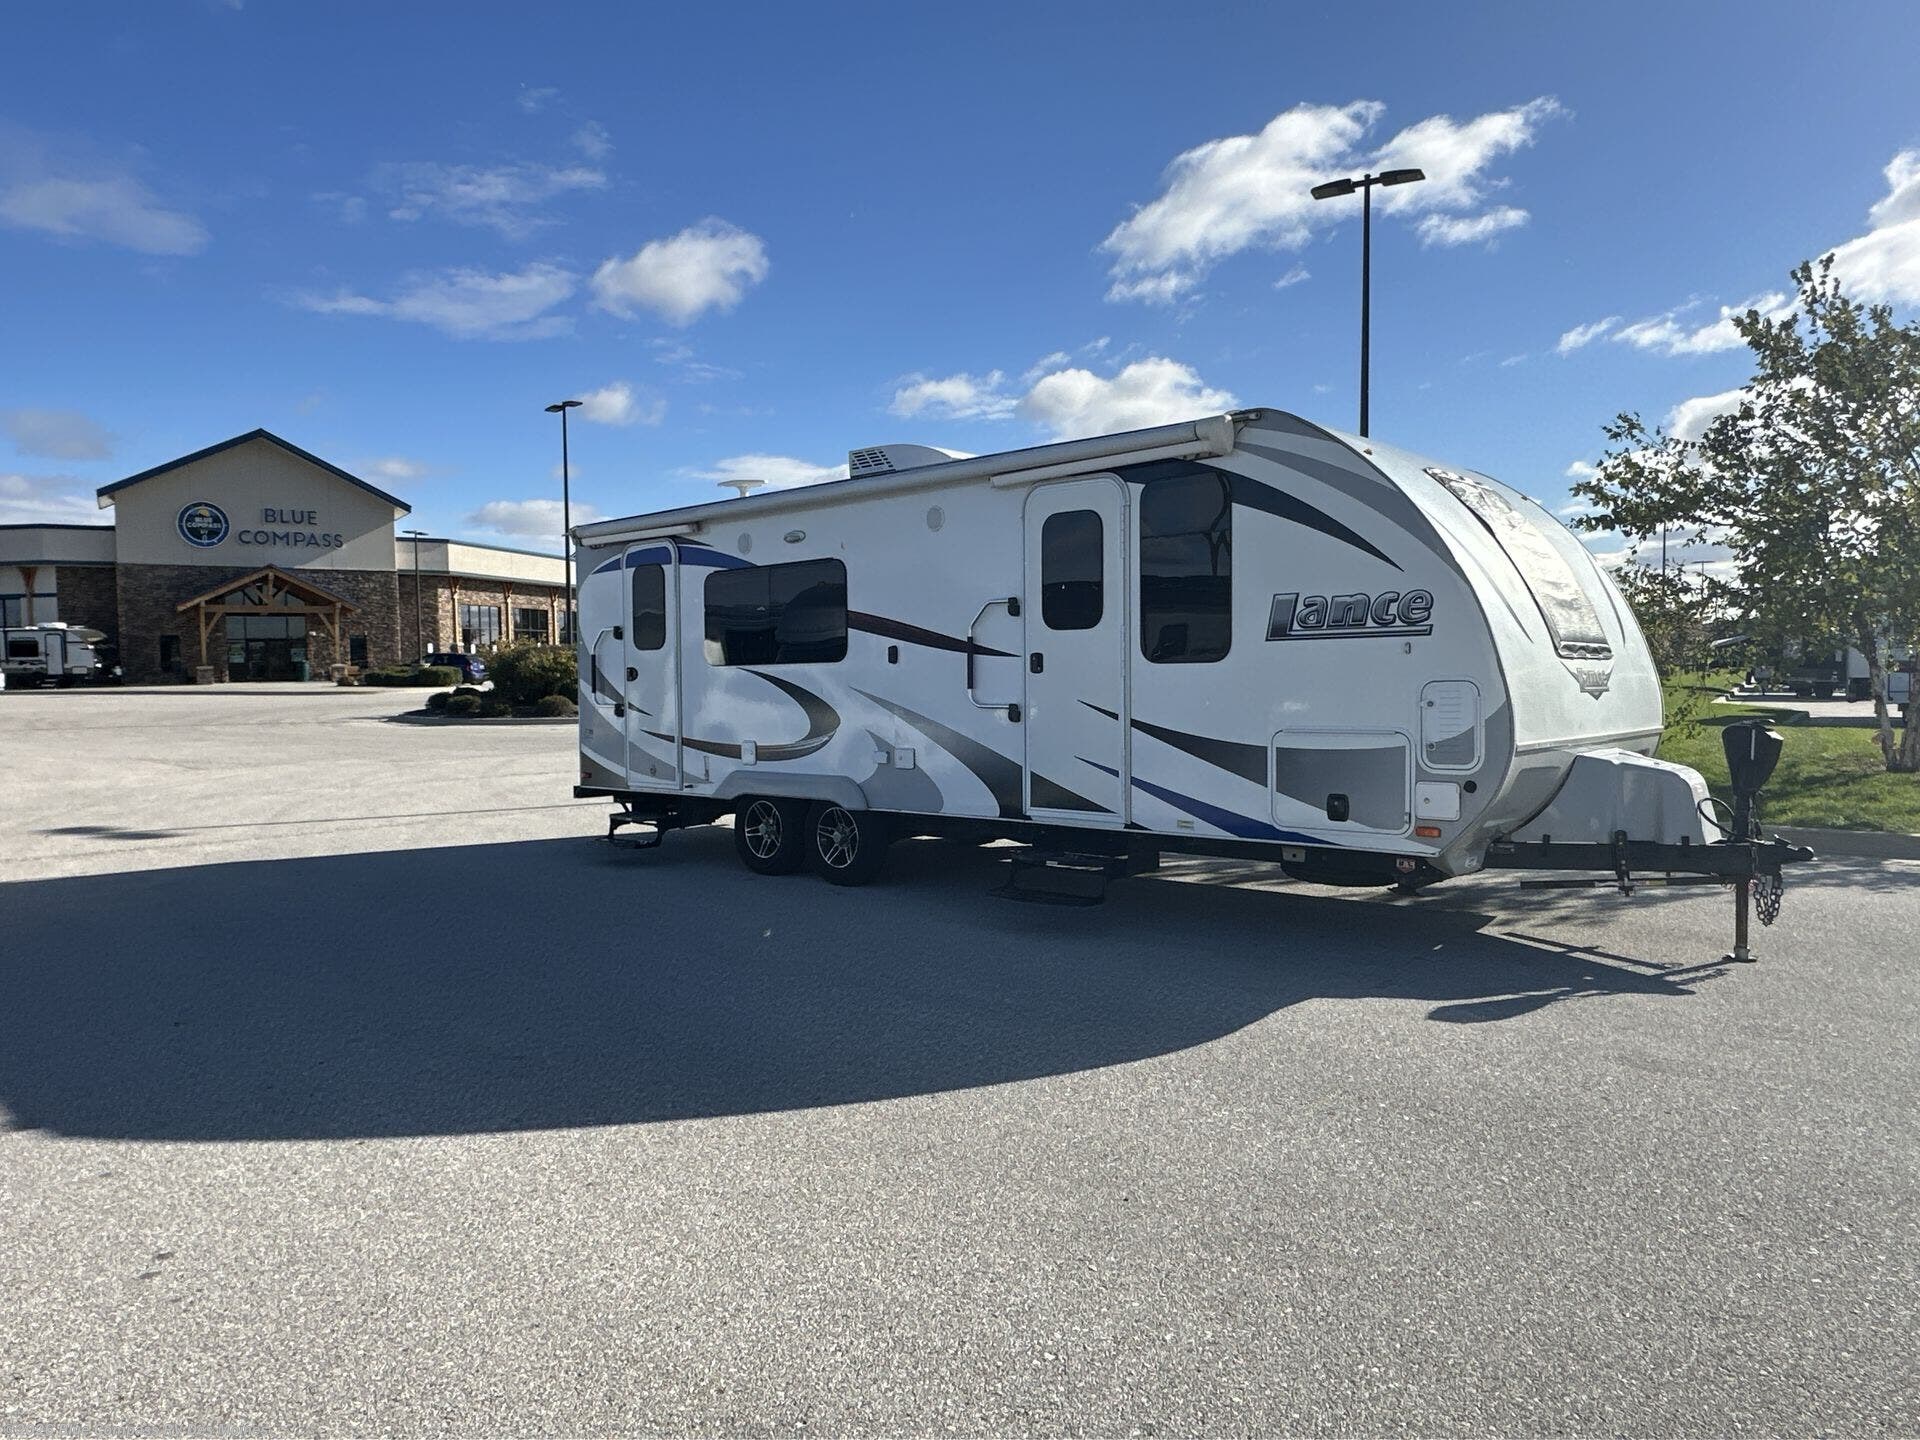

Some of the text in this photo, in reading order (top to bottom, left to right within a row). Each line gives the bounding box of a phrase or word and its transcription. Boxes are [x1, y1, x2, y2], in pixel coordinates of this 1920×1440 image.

[264, 508, 318, 526] BLUE
[238, 530, 344, 549] COMPASS
[1265, 589, 1434, 641] Lance
